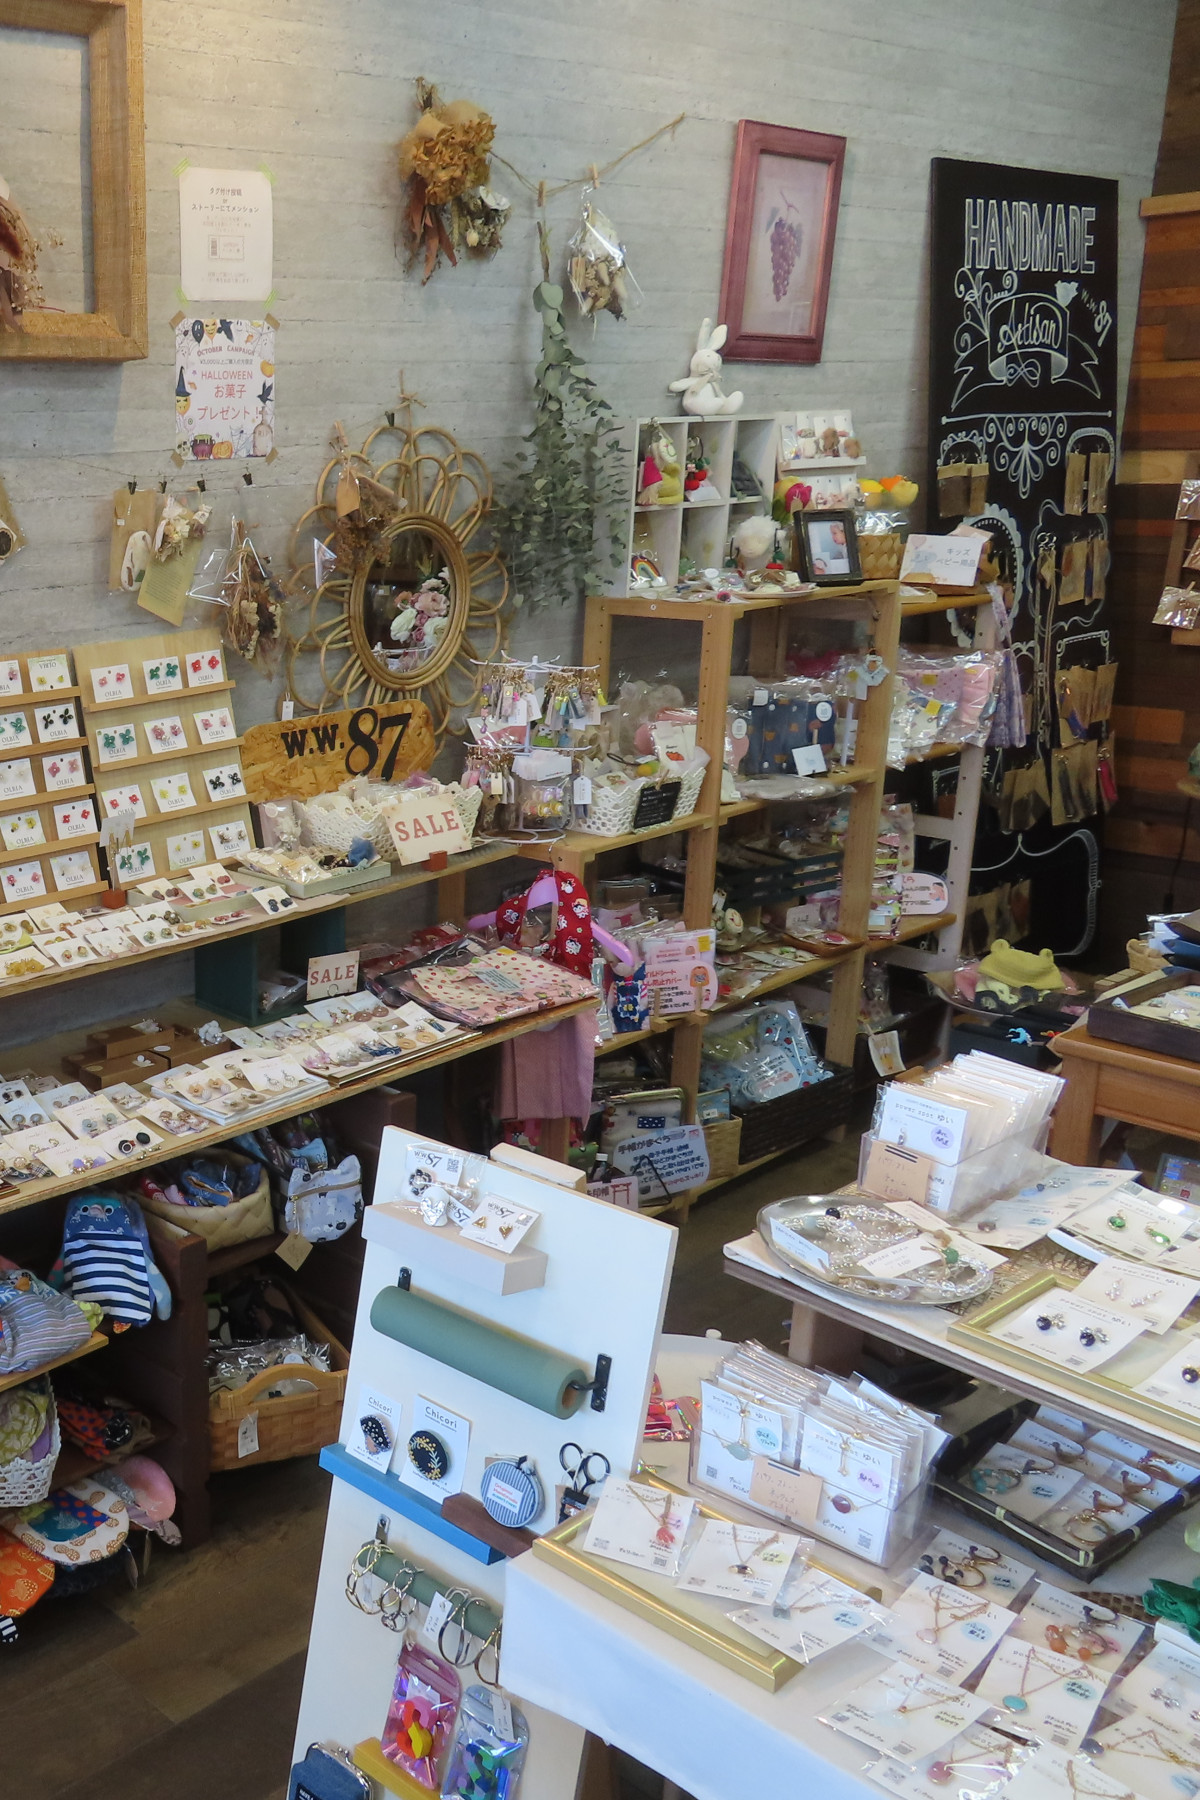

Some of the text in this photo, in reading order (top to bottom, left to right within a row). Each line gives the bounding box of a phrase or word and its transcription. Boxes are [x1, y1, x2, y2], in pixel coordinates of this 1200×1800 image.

[191, 203, 259, 213] ストーリーにてメンション
[964, 199, 1096, 274] HANDMADE
[997, 299, 1063, 353] Artisan
[196, 346, 222, 356] OCTOBER
[201, 370, 253, 380] HALLOWEEN
[214, 384, 246, 398] お菓子
[947, 548, 971, 556] キッズ
[281, 707, 412, 782] W.W.87
[394, 810, 459, 842] SALE
[310, 964, 356, 986] SALE
[368, 1396, 392, 1414] Chicori
[426, 1406, 458, 1428] Chicori
